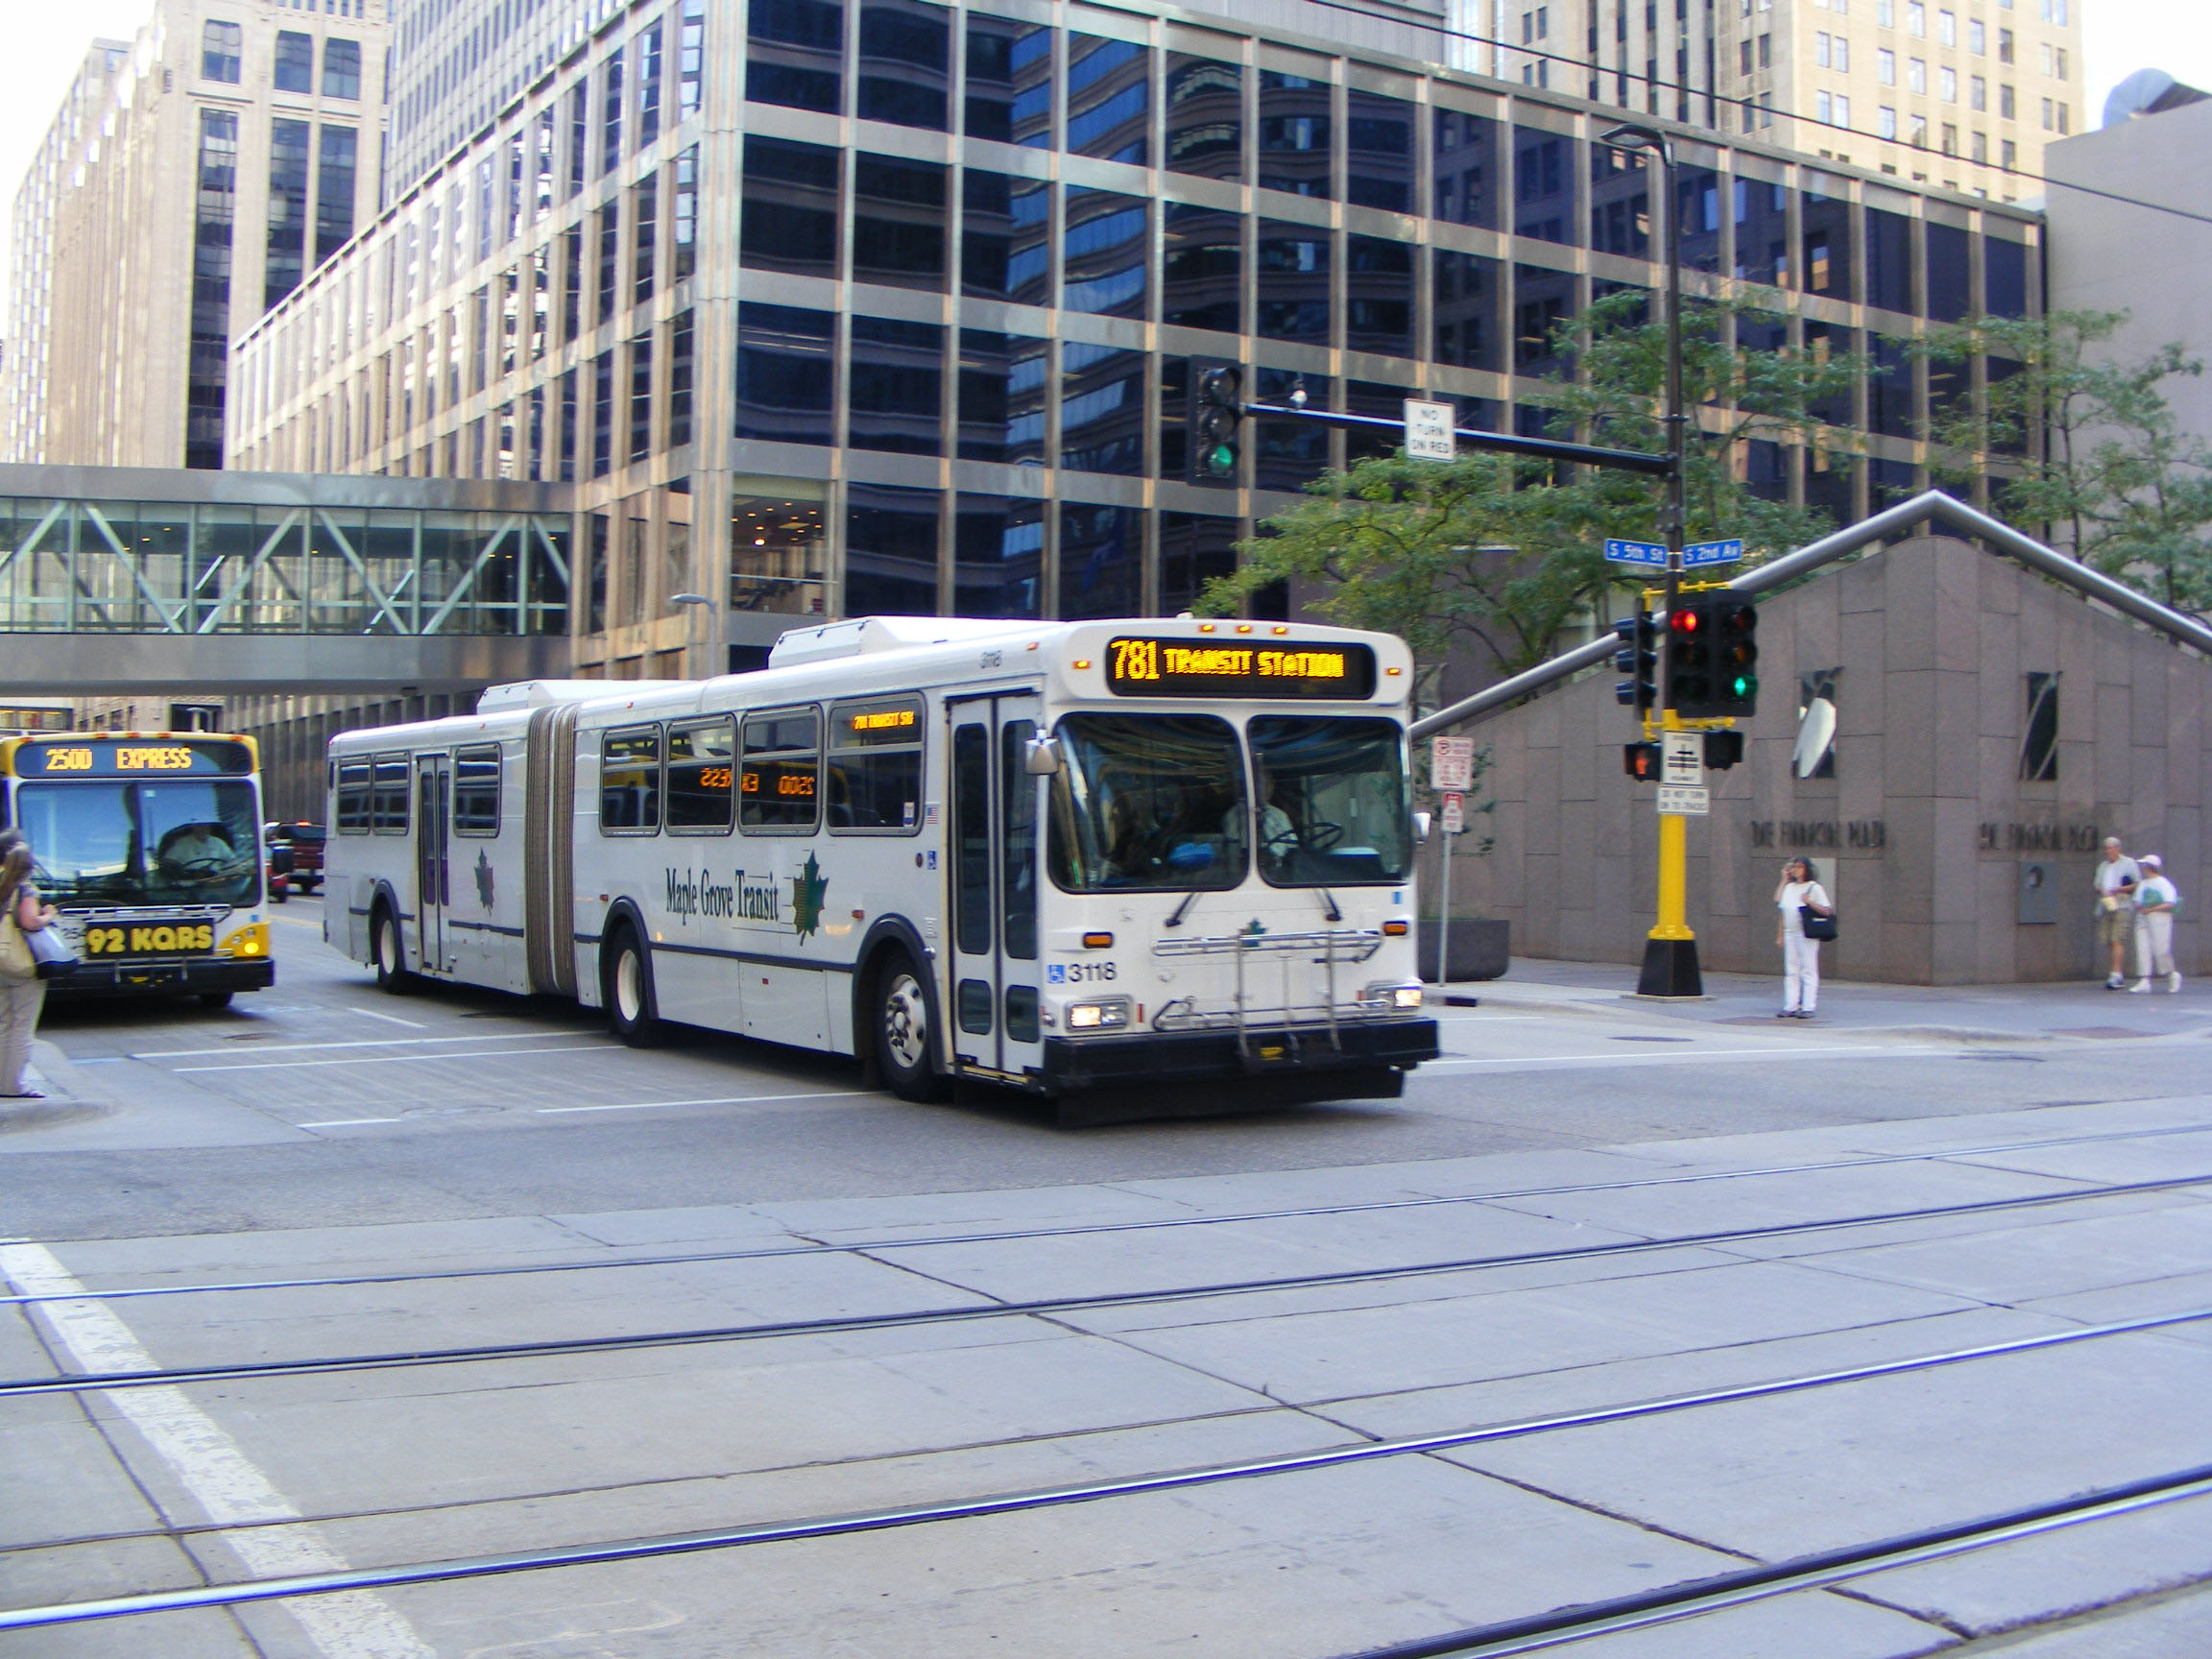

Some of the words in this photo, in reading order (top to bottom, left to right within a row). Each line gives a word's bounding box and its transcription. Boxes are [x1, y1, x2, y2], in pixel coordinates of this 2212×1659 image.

[1609, 542, 1620, 557] S
[1685, 548, 1695, 563] S
[1697, 545, 1719, 561] 2nd
[1110, 639, 1160, 681] 781
[1163, 647, 1253, 675] TRANSIT
[1257, 651, 1344, 678] STATION
[116, 747, 192, 770] EXPRESS
[665, 866, 697, 926] Maple
[701, 868, 733, 919] Grove
[735, 869, 779, 922] Transit
[86, 927, 126, 953] 92
[131, 925, 213, 951] KQRS
[1069, 962, 1118, 982] 3118
